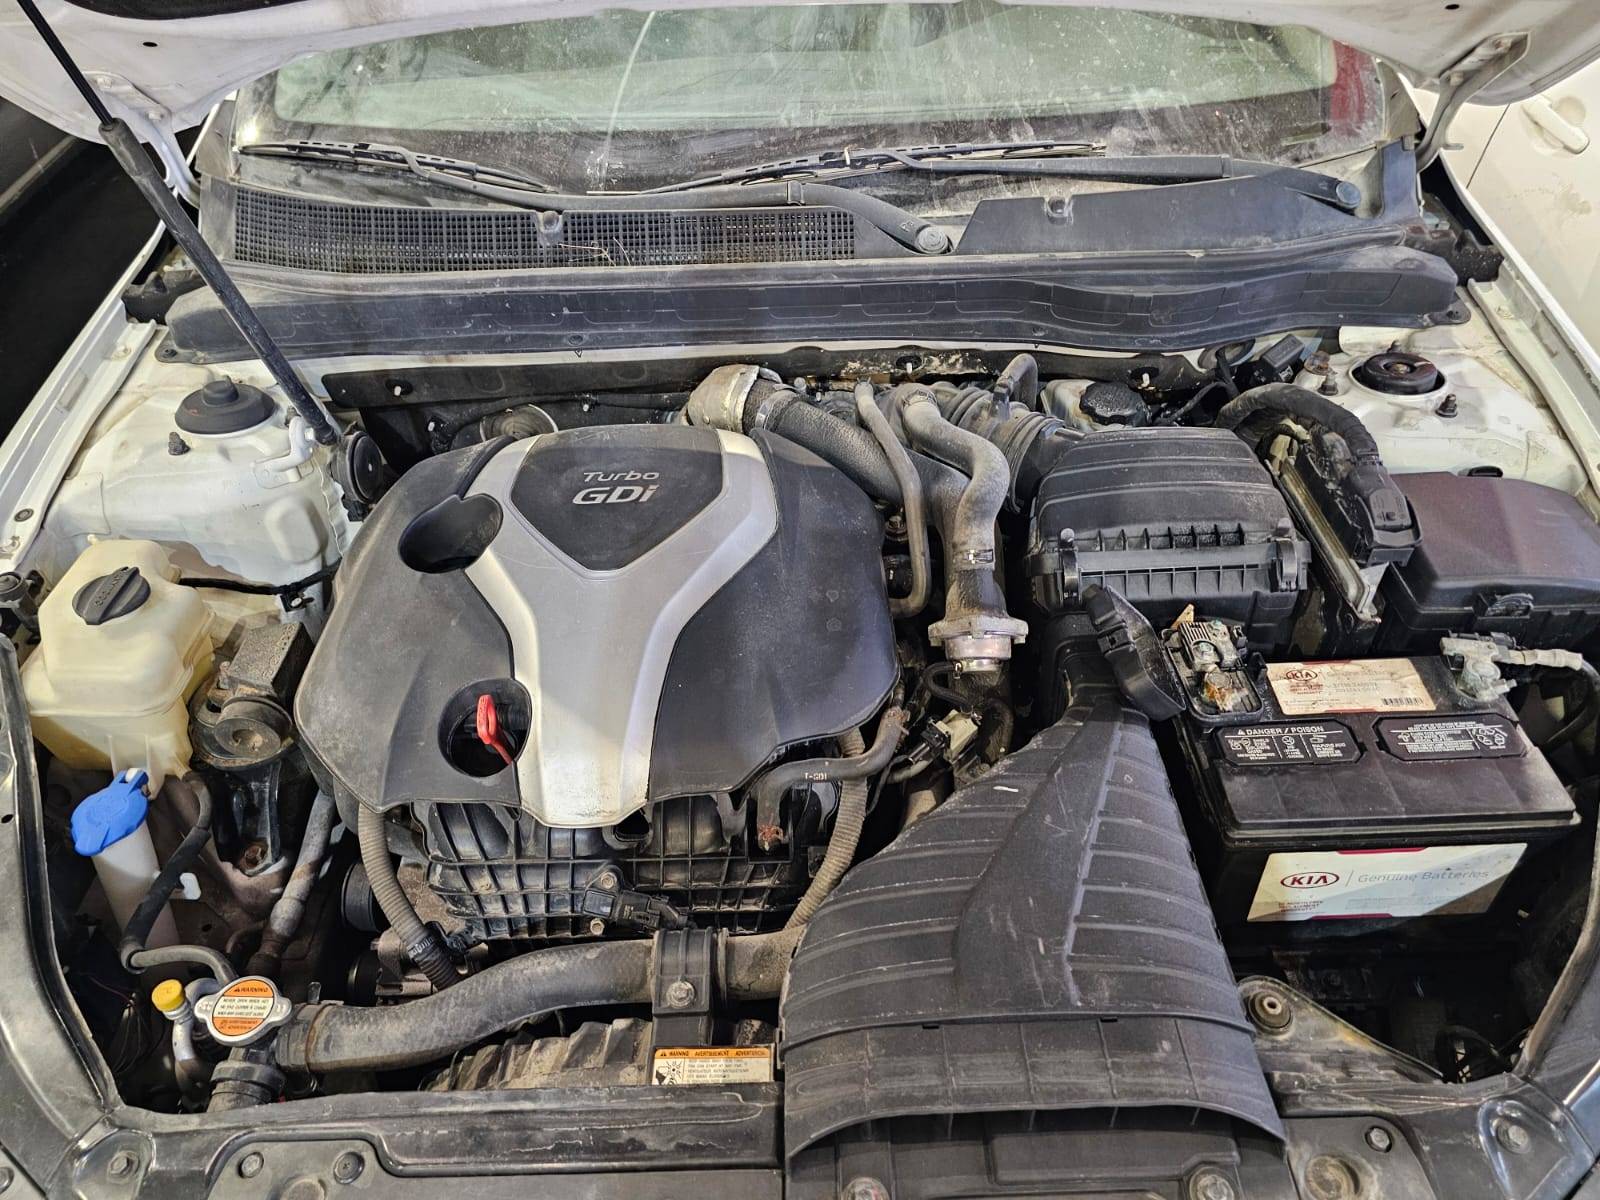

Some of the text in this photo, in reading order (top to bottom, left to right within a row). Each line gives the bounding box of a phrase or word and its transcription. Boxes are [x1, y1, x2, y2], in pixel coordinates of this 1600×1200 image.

[583, 470, 660, 482] Turbo
[572, 484, 660, 505] GDi
[1290, 874, 1332, 886] KIA
[1358, 870, 1489, 884] Genuine Batteries
